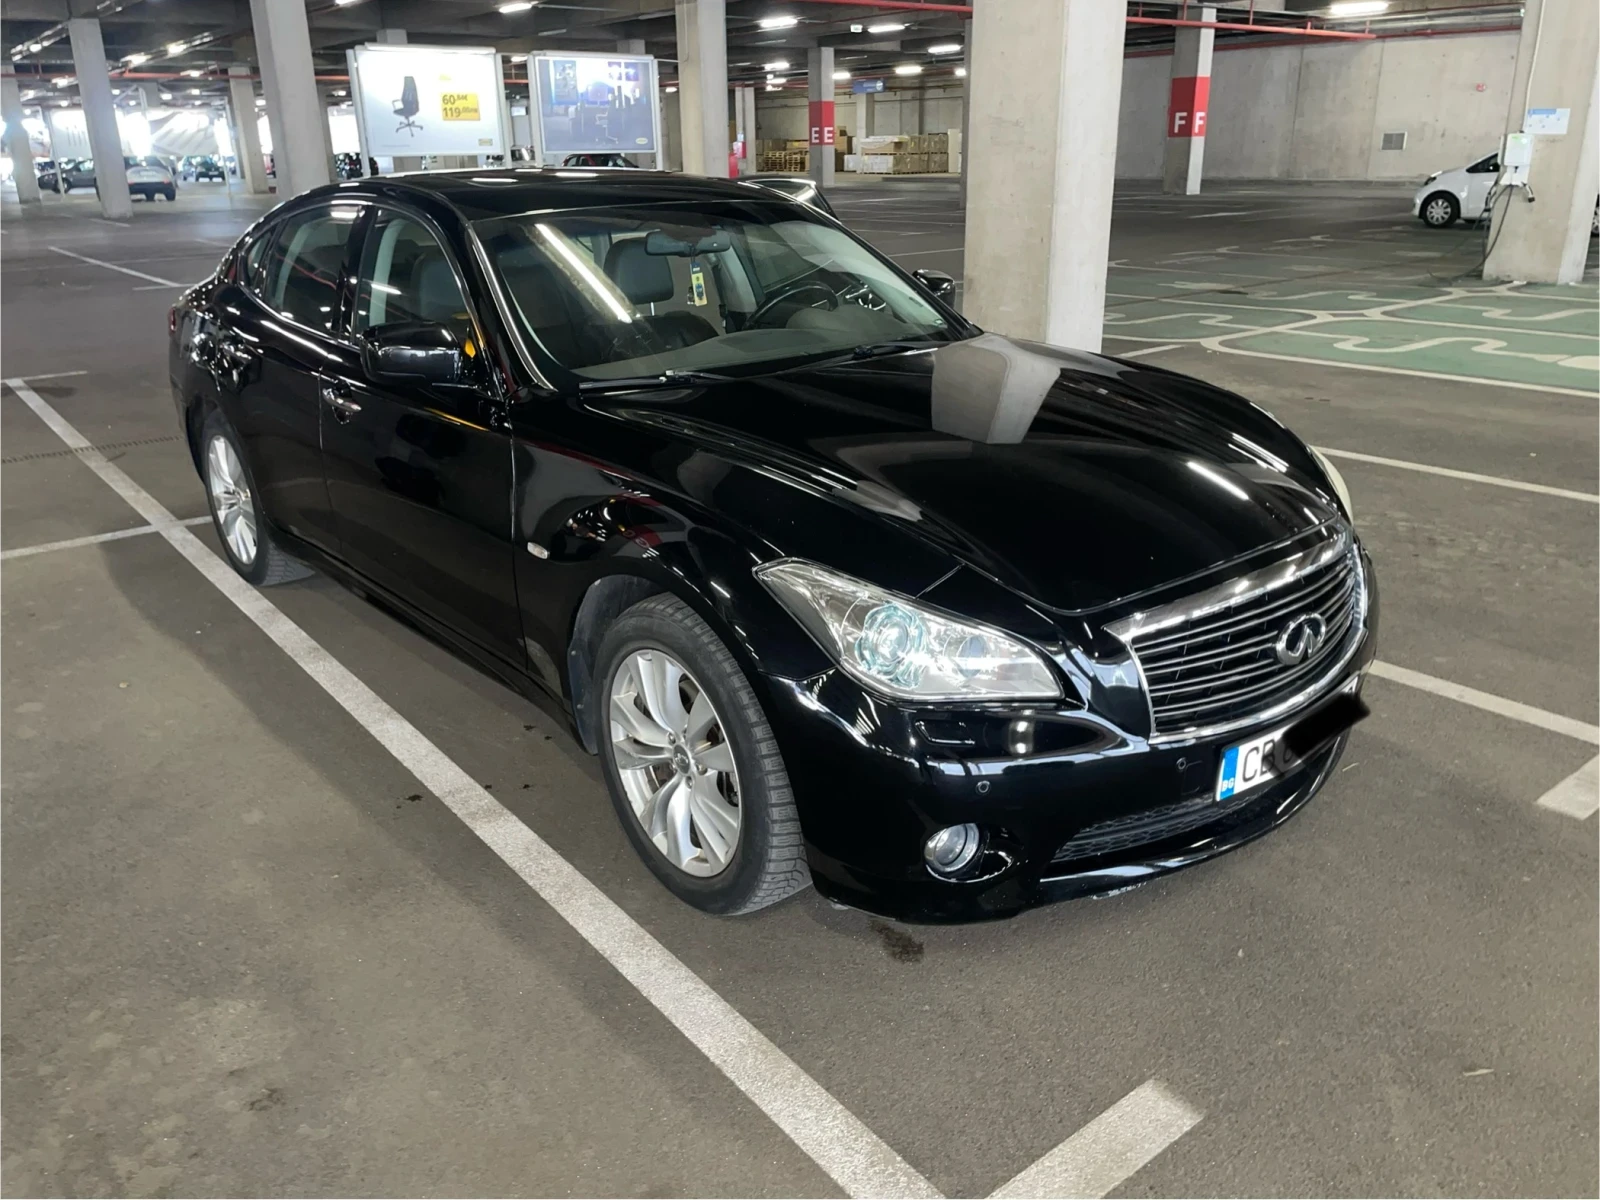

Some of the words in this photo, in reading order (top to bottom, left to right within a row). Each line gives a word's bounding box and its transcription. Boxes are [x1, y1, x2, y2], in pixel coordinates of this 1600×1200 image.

[442, 94, 456, 105] 60
[443, 107, 461, 118] 119
[1174, 112, 1188, 133] F
[1194, 111, 1206, 133] F
[811, 127, 820, 143] E
[823, 126, 834, 143] E
[1221, 777, 1235, 792] BG
